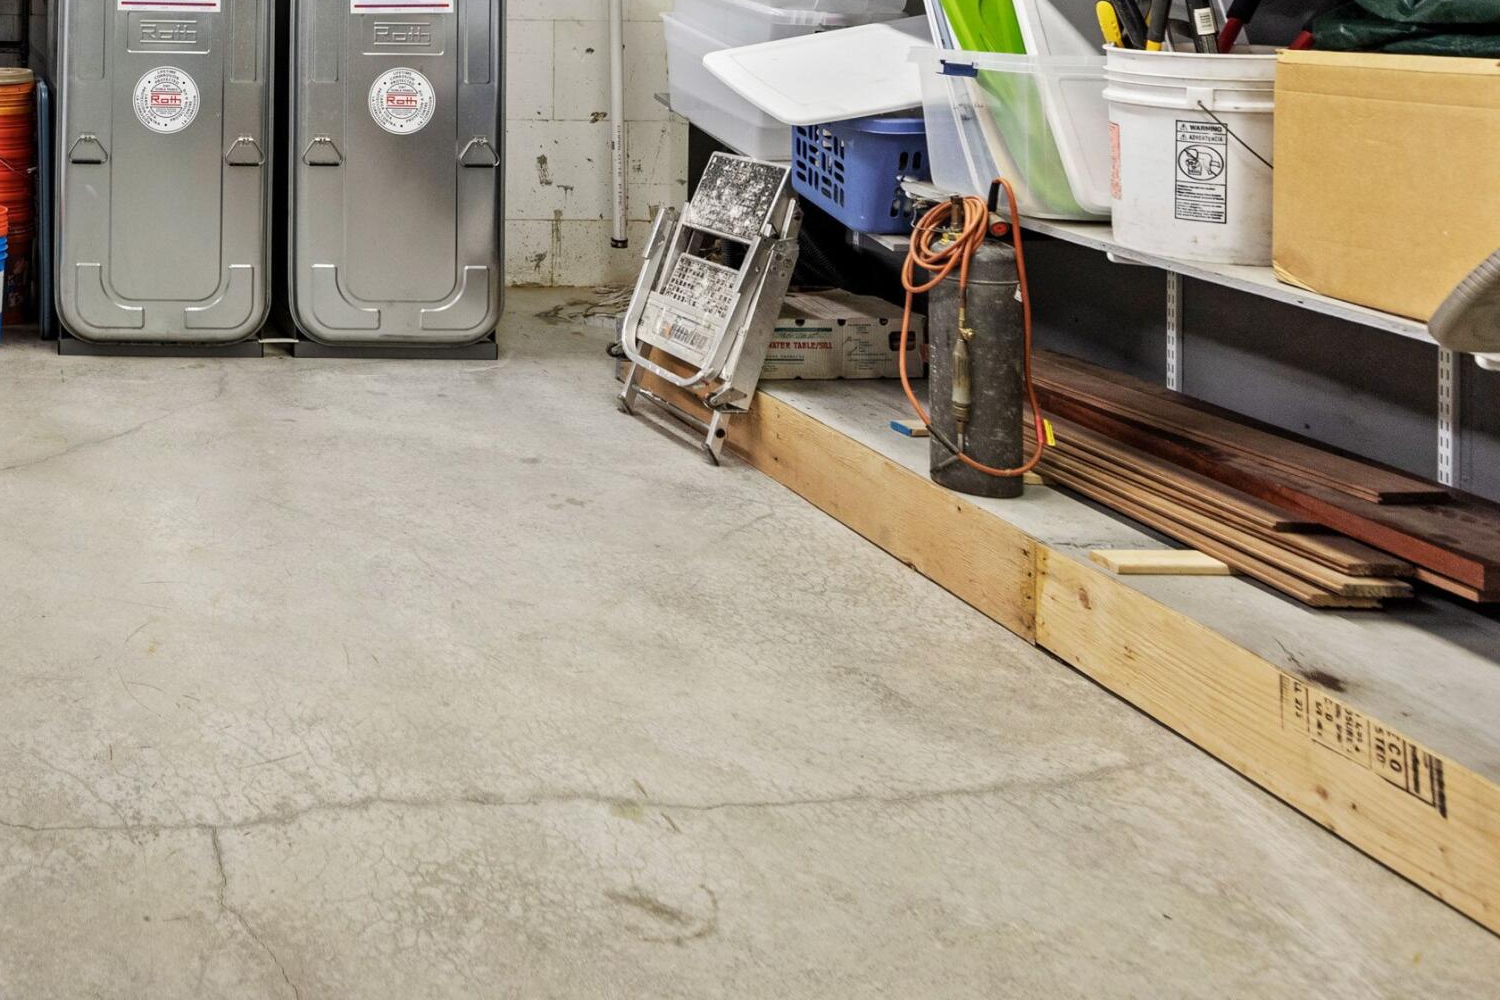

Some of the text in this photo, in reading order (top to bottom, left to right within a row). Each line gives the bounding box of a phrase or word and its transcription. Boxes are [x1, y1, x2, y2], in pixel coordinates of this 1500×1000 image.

[140, 22, 196, 42] Roth
[374, 24, 430, 44] Roth
[151, 94, 181, 105] Roth
[387, 95, 417, 106] Roth
[794, 342, 832, 350] TABLE/SILL
